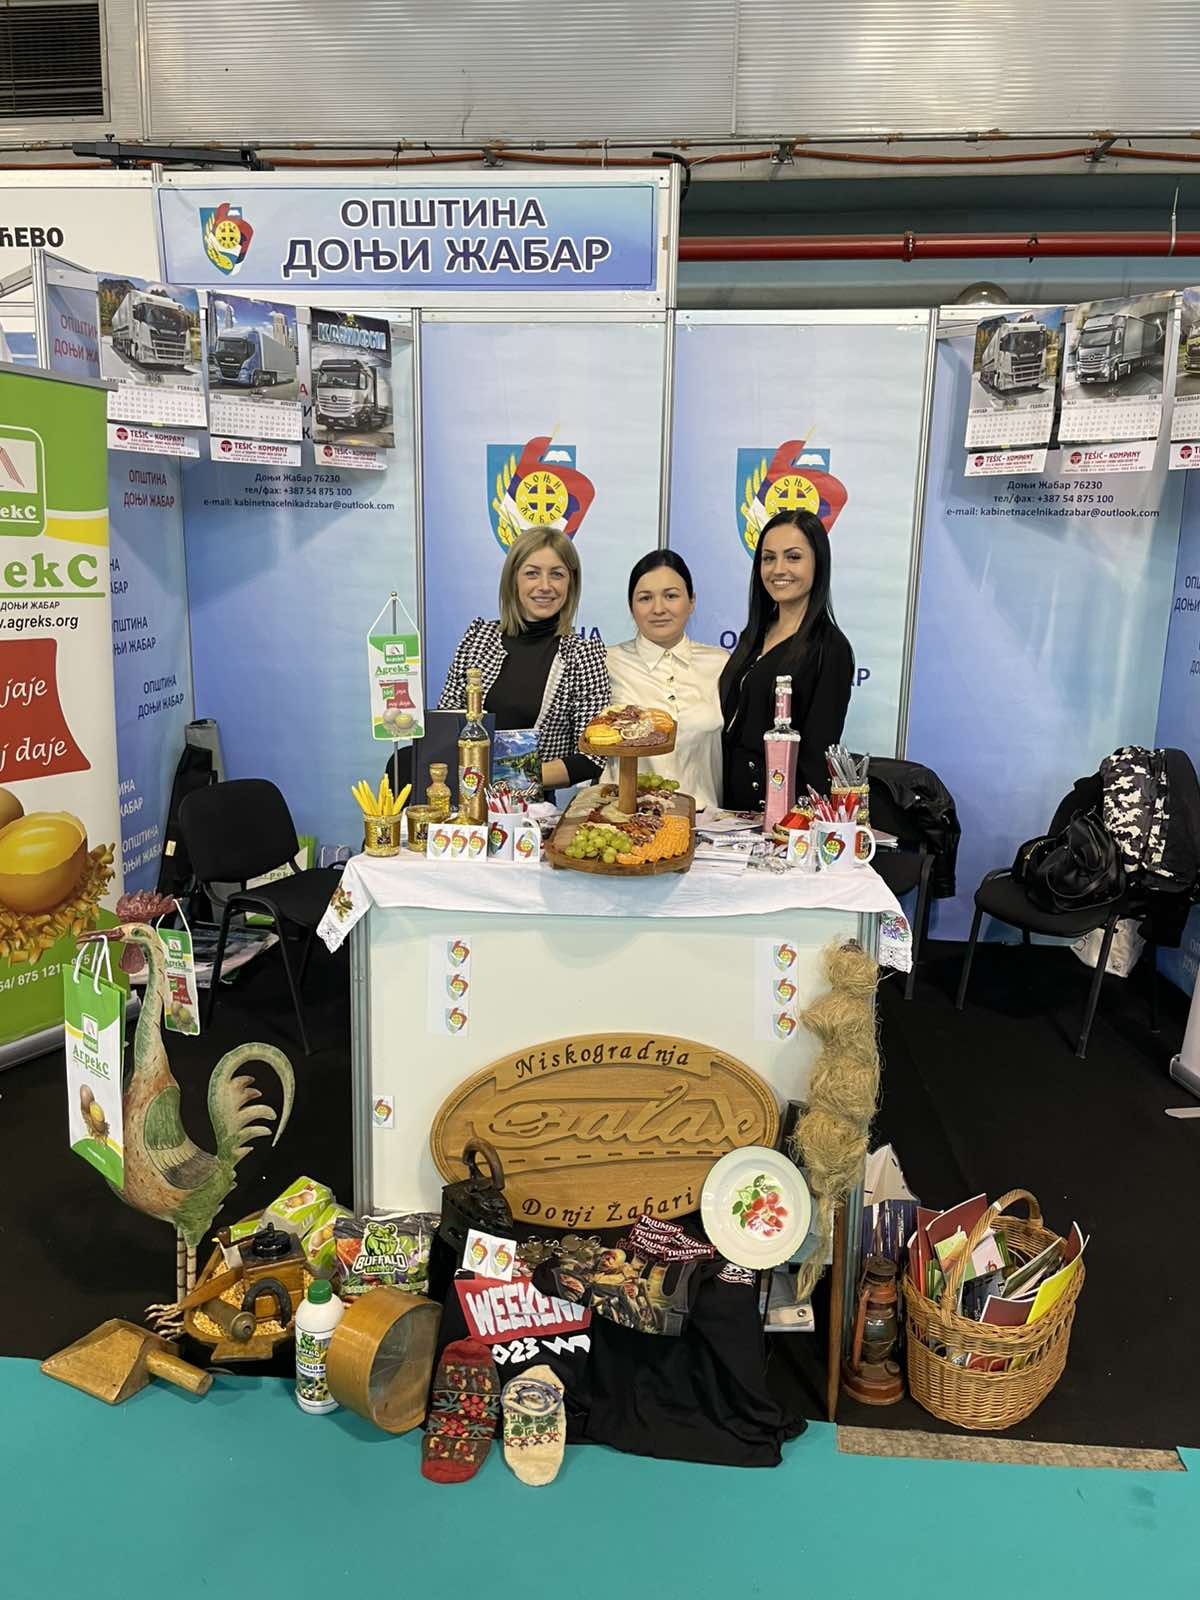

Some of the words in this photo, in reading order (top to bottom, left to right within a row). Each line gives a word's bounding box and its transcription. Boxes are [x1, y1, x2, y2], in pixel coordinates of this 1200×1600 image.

[342, 198, 546, 228] ОПШТИНА
[283, 239, 430, 279] ДОЊИ
[445, 238, 611, 272] ЖАБАР
[54, 338, 85, 361] ДОЊИ
[129, 469, 168, 486] ОПШТИНА
[255, 473, 281, 483] Доњи
[283, 473, 312, 484] Жабар
[314, 474, 340, 483] 76230
[1007, 481, 1036, 490] Доњи
[1038, 480, 1071, 491] Жабар
[1073, 481, 1102, 490] 76230
[124, 491, 148, 508] ДОЊИ
[149, 494, 175, 508] ЖАБАР
[245, 486, 282, 496] тел/фах:
[283, 486, 304, 496] +387
[306, 487, 317, 496] 54
[318, 487, 334, 496] 875
[336, 488, 352, 496] 100
[993, 494, 1035, 504] тел/фах:
[1036, 495, 1061, 503] +387
[1062, 494, 1074, 503] 54
[1076, 495, 1094, 503] 875
[1096, 495, 1114, 503] 100
[203, 498, 233, 507] e-mail:
[234, 498, 395, 510] kabinetnacelnikadzabar@outlook.com
[946, 508, 979, 517] e-mail:
[980, 507, 1160, 518] kabinetnacelnikadzabar@outlook.com
[0, 601, 28, 612] ДОЊИ
[30, 601, 60, 609] ЖАБАР
[112, 616, 148, 632] ПШТИНА
[129, 637, 157, 653] ЖАБАР
[0, 676, 48, 708] jaje
[143, 674, 177, 694] ОПШТИНА
[137, 700, 162, 720] ДОЊИ
[16, 736, 67, 766] daje
[122, 824, 160, 853] ОПШТИНА
[142, 843, 162, 864] ЖАБА
[17, 970, 39, 986] 875
[41, 962, 61, 978] 121
[515, 1040, 690, 1080] Niskogradnja
[522, 1197, 593, 1227] Donji
[607, 1186, 695, 1222] Žabari
[640, 1214, 682, 1233] TRIUMPH
[634, 1228, 671, 1243] TRIUMP
[355, 1253, 406, 1270] BUFFALO
[491, 1337, 540, 1365] 023
